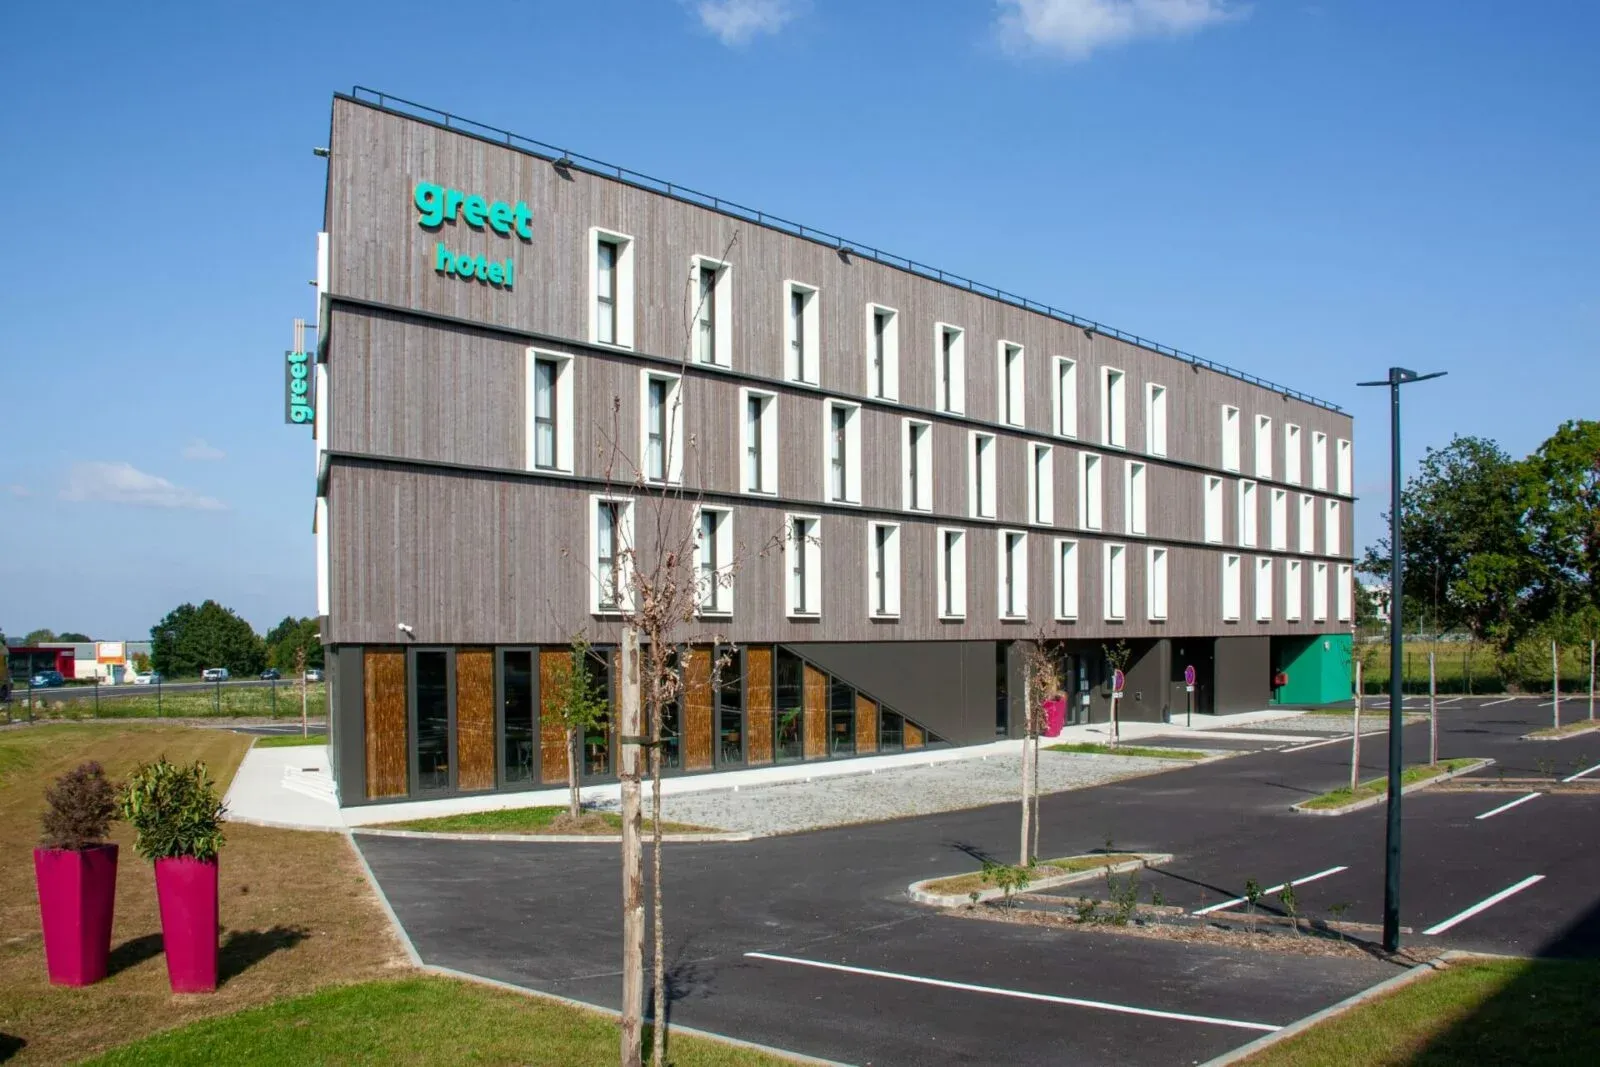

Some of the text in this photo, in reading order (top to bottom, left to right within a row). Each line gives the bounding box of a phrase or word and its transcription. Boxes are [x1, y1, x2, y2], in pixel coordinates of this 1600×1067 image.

[414, 181, 533, 239] greet
[435, 241, 514, 286] hotel
[287, 351, 313, 422] greet
